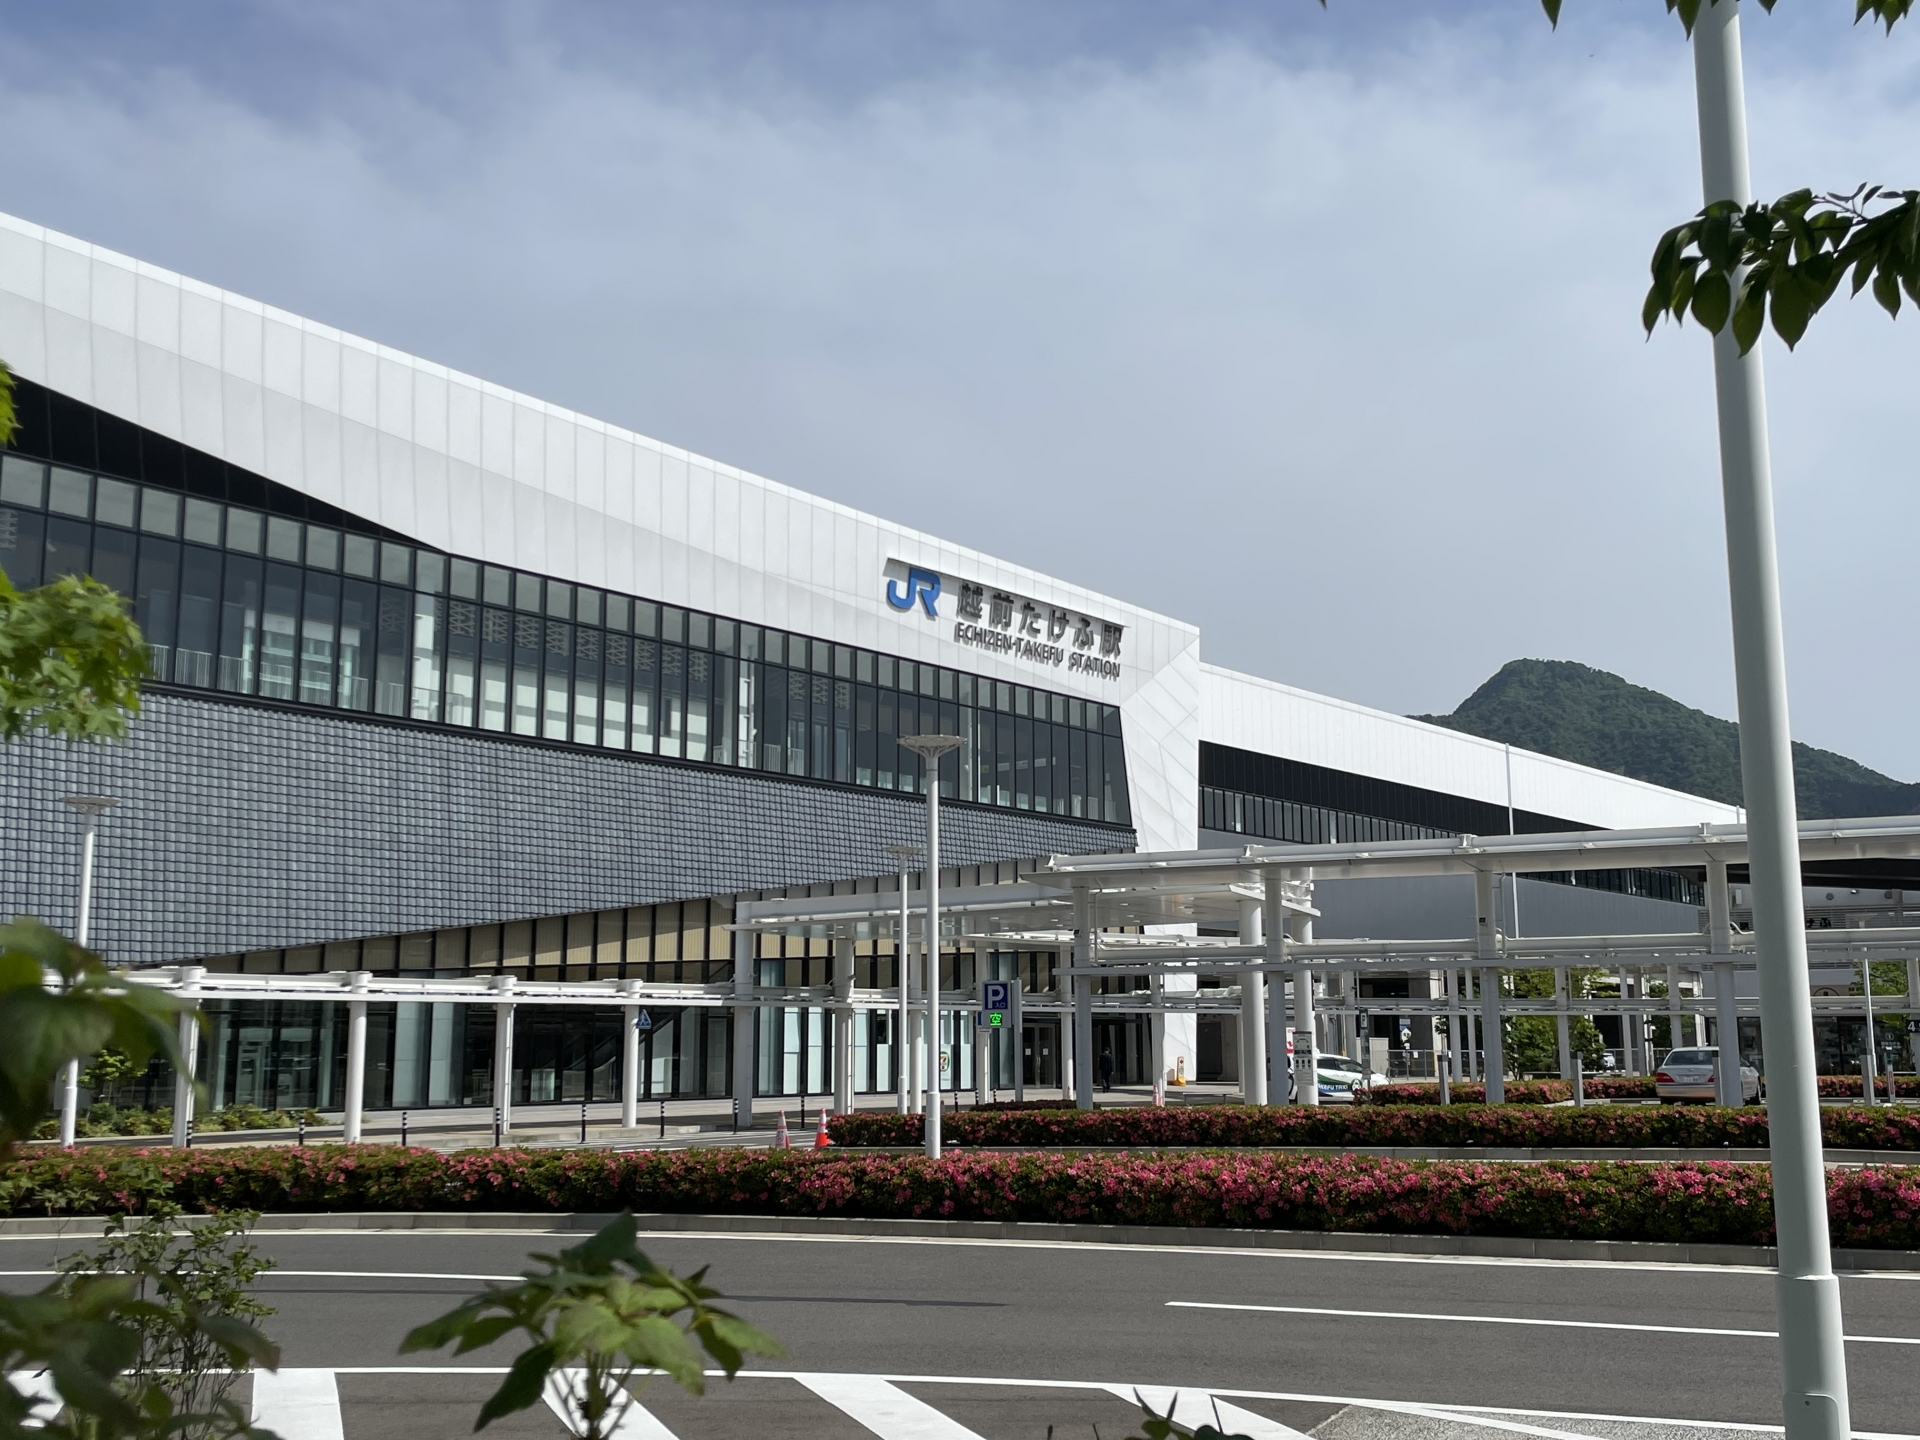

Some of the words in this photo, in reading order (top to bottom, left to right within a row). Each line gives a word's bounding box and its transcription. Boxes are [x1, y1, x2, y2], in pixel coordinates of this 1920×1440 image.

[887, 567, 941, 617] JR
[958, 583, 1123, 656] 越前たけふ駅
[955, 621, 1064, 666] ECHIZEN-TAKEFU
[1069, 651, 1121, 679] STATION
[988, 985, 1005, 1009] P
[989, 1012, 1002, 1026] 空
[1907, 1020, 1916, 1032] 4
